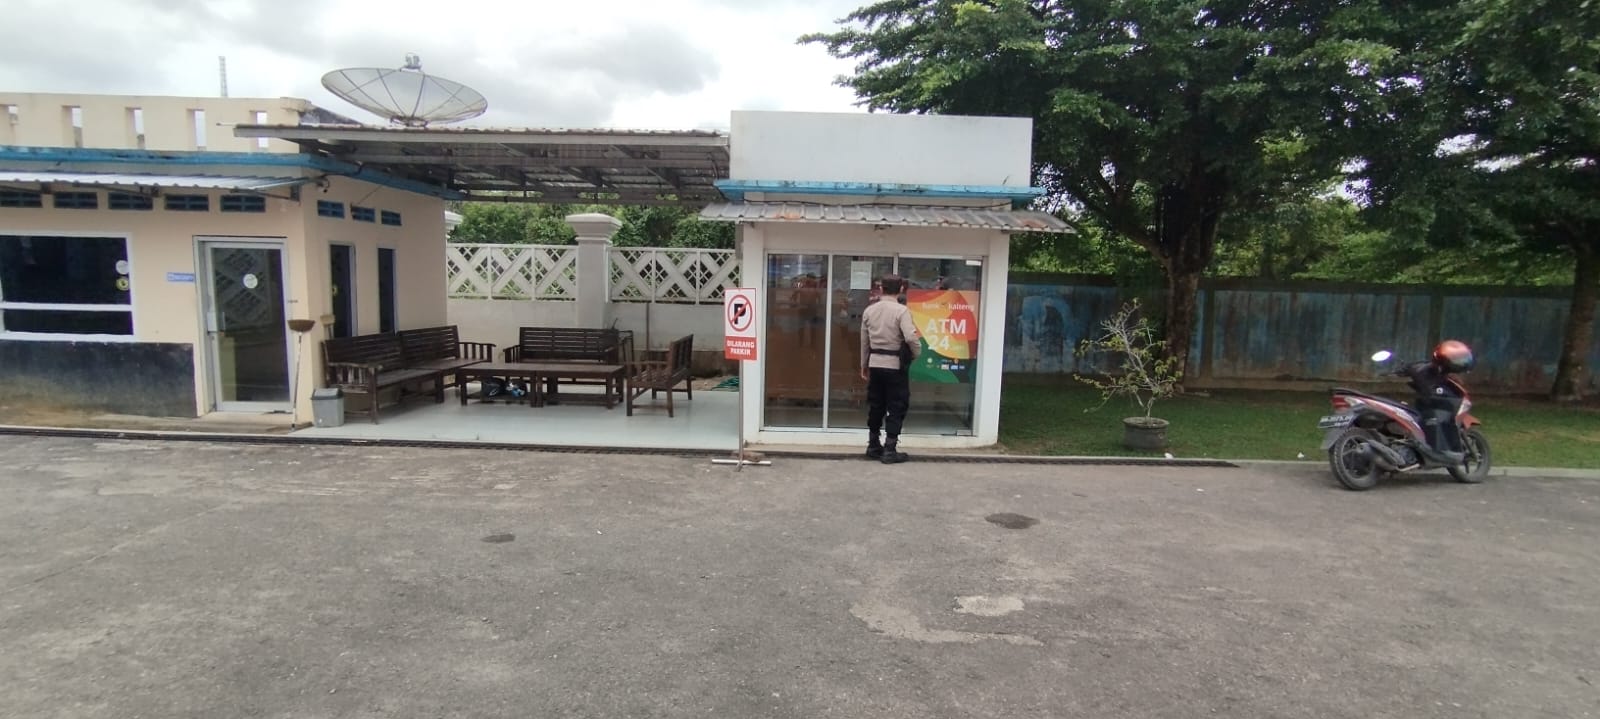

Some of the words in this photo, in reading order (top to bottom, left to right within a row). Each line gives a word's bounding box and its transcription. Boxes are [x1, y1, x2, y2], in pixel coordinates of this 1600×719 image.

[734, 304, 746, 324] P
[925, 319, 967, 334] ATM
[727, 340, 754, 348] DILARANG
[928, 335, 949, 350] 24
